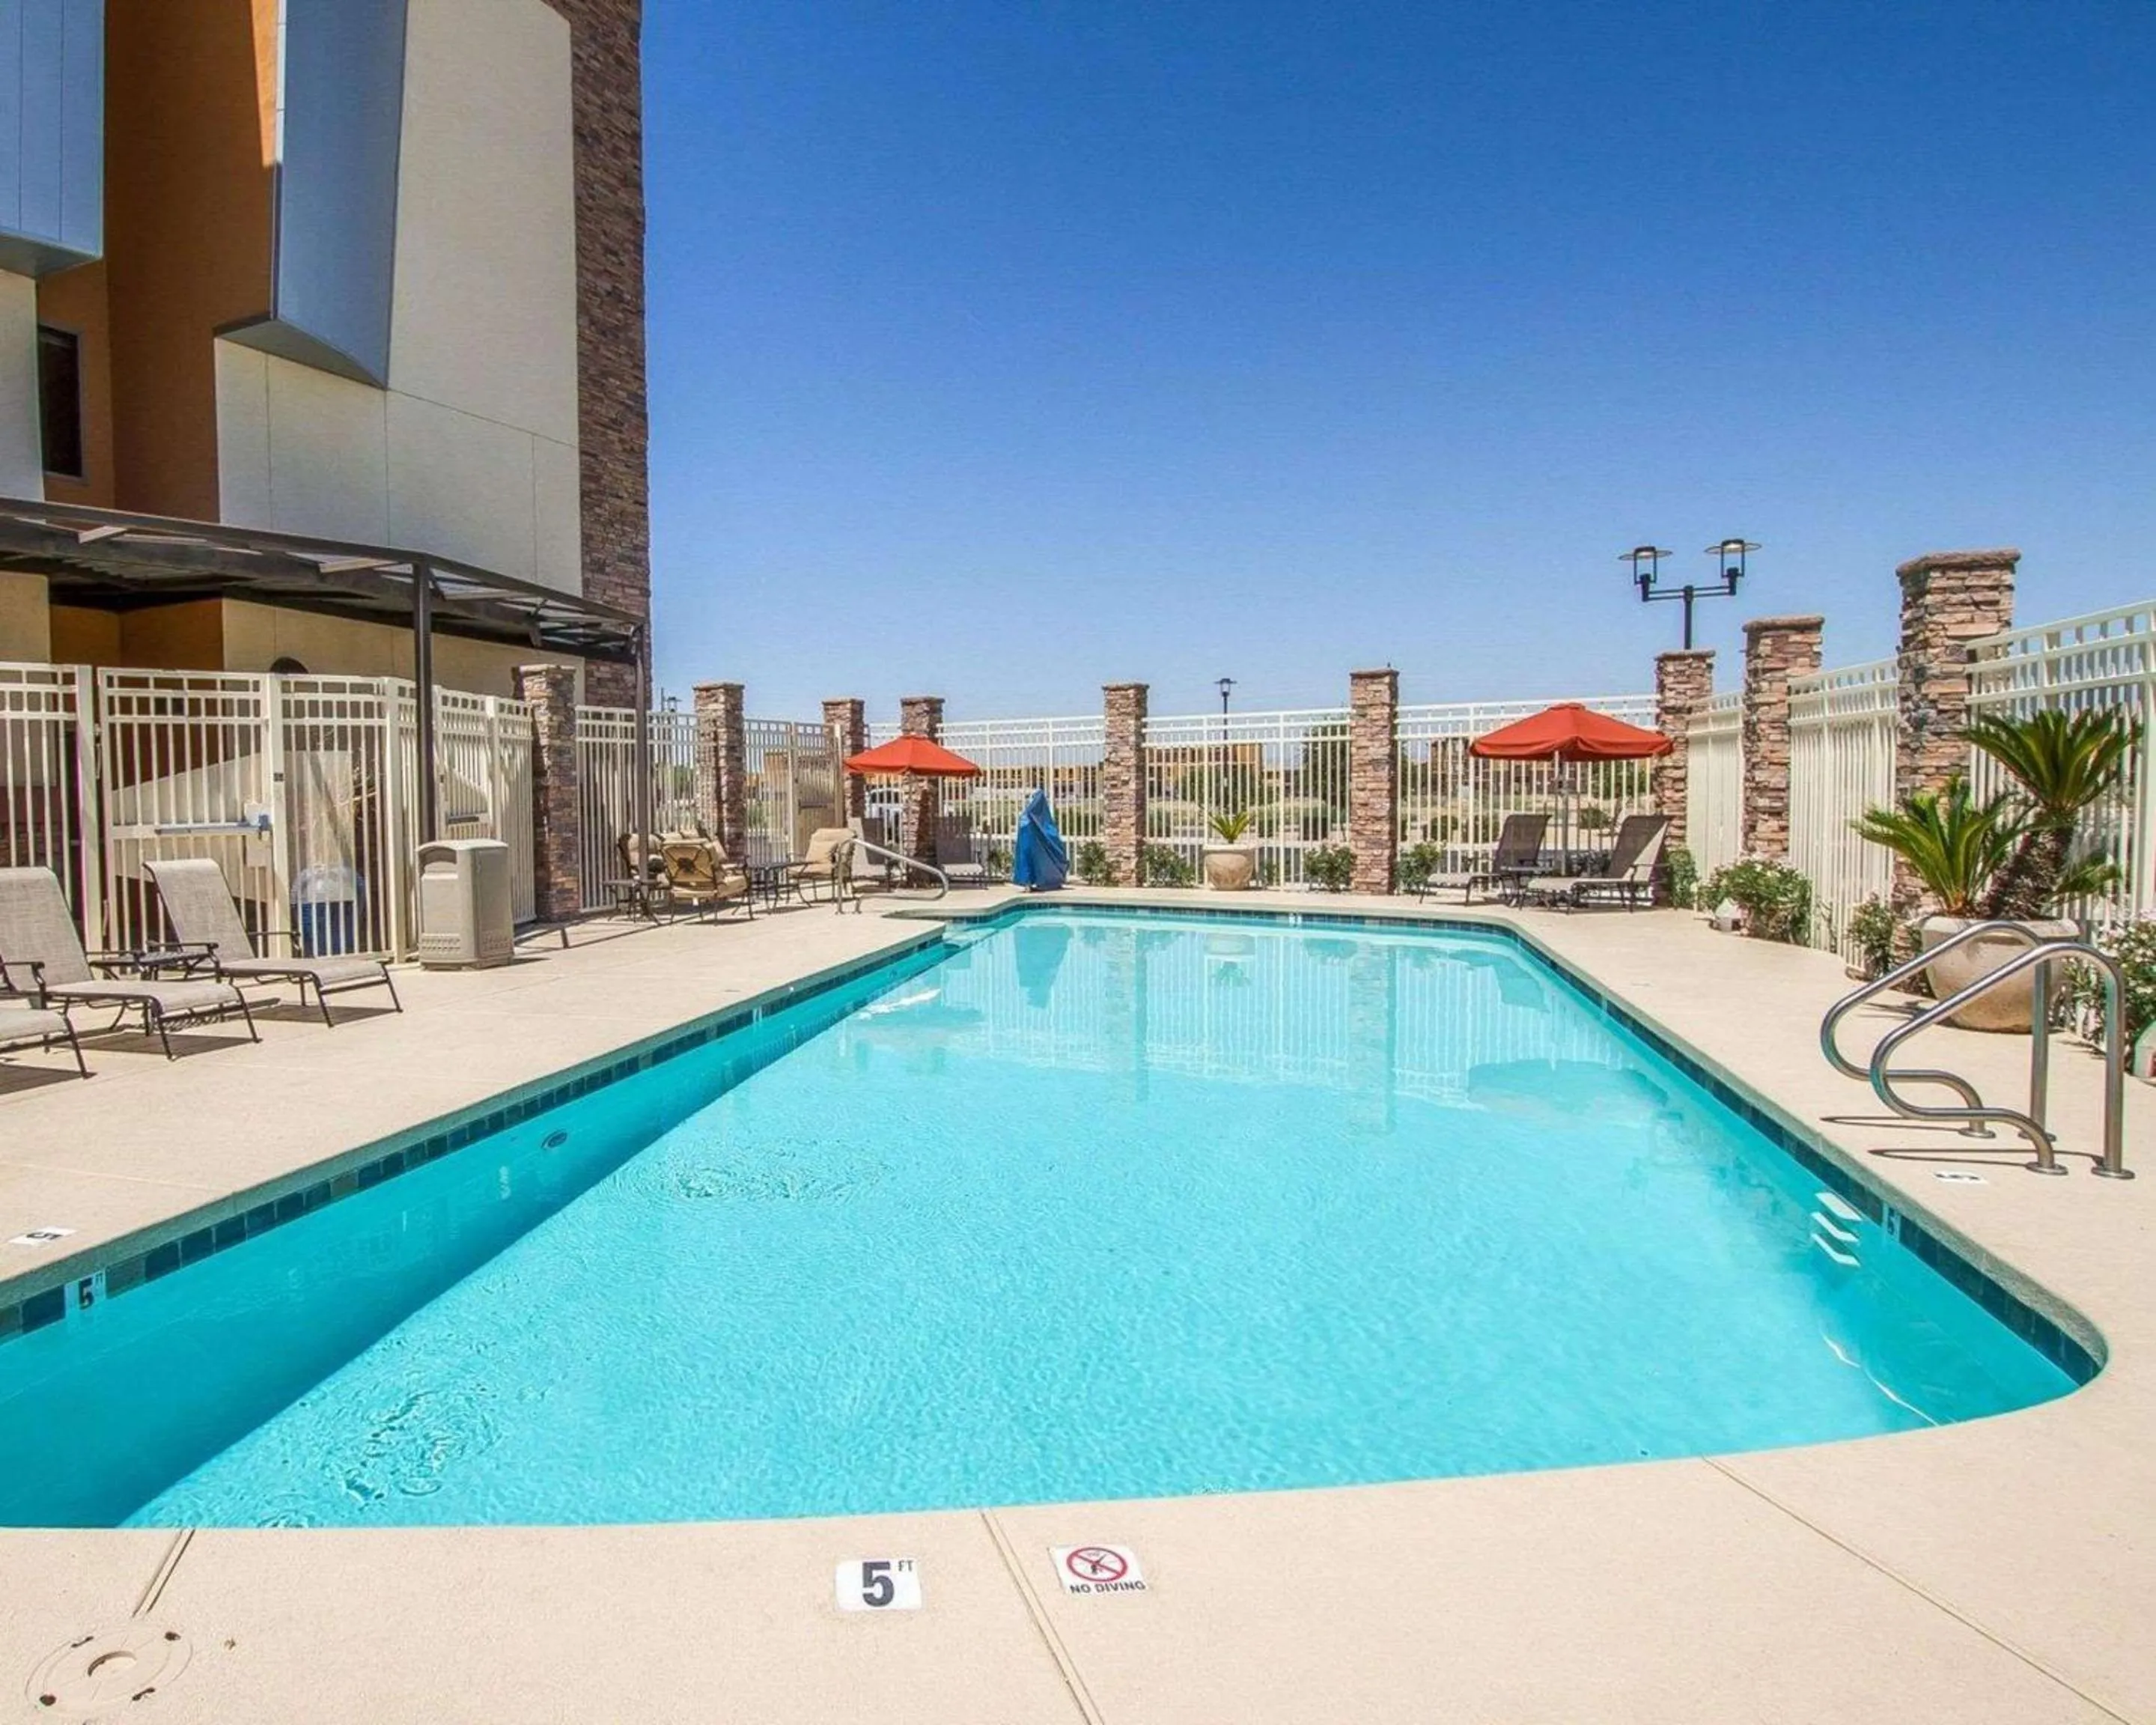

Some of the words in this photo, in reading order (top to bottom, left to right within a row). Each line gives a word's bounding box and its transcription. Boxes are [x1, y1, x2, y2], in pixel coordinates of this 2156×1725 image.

[26, 1232, 63, 1240] 5
[79, 1277, 94, 1310] 5
[862, 1561, 895, 1607] 5
[898, 1560, 913, 1572] FT
[1070, 1583, 1091, 1593] NO
[1095, 1581, 1146, 1592] DIVING
